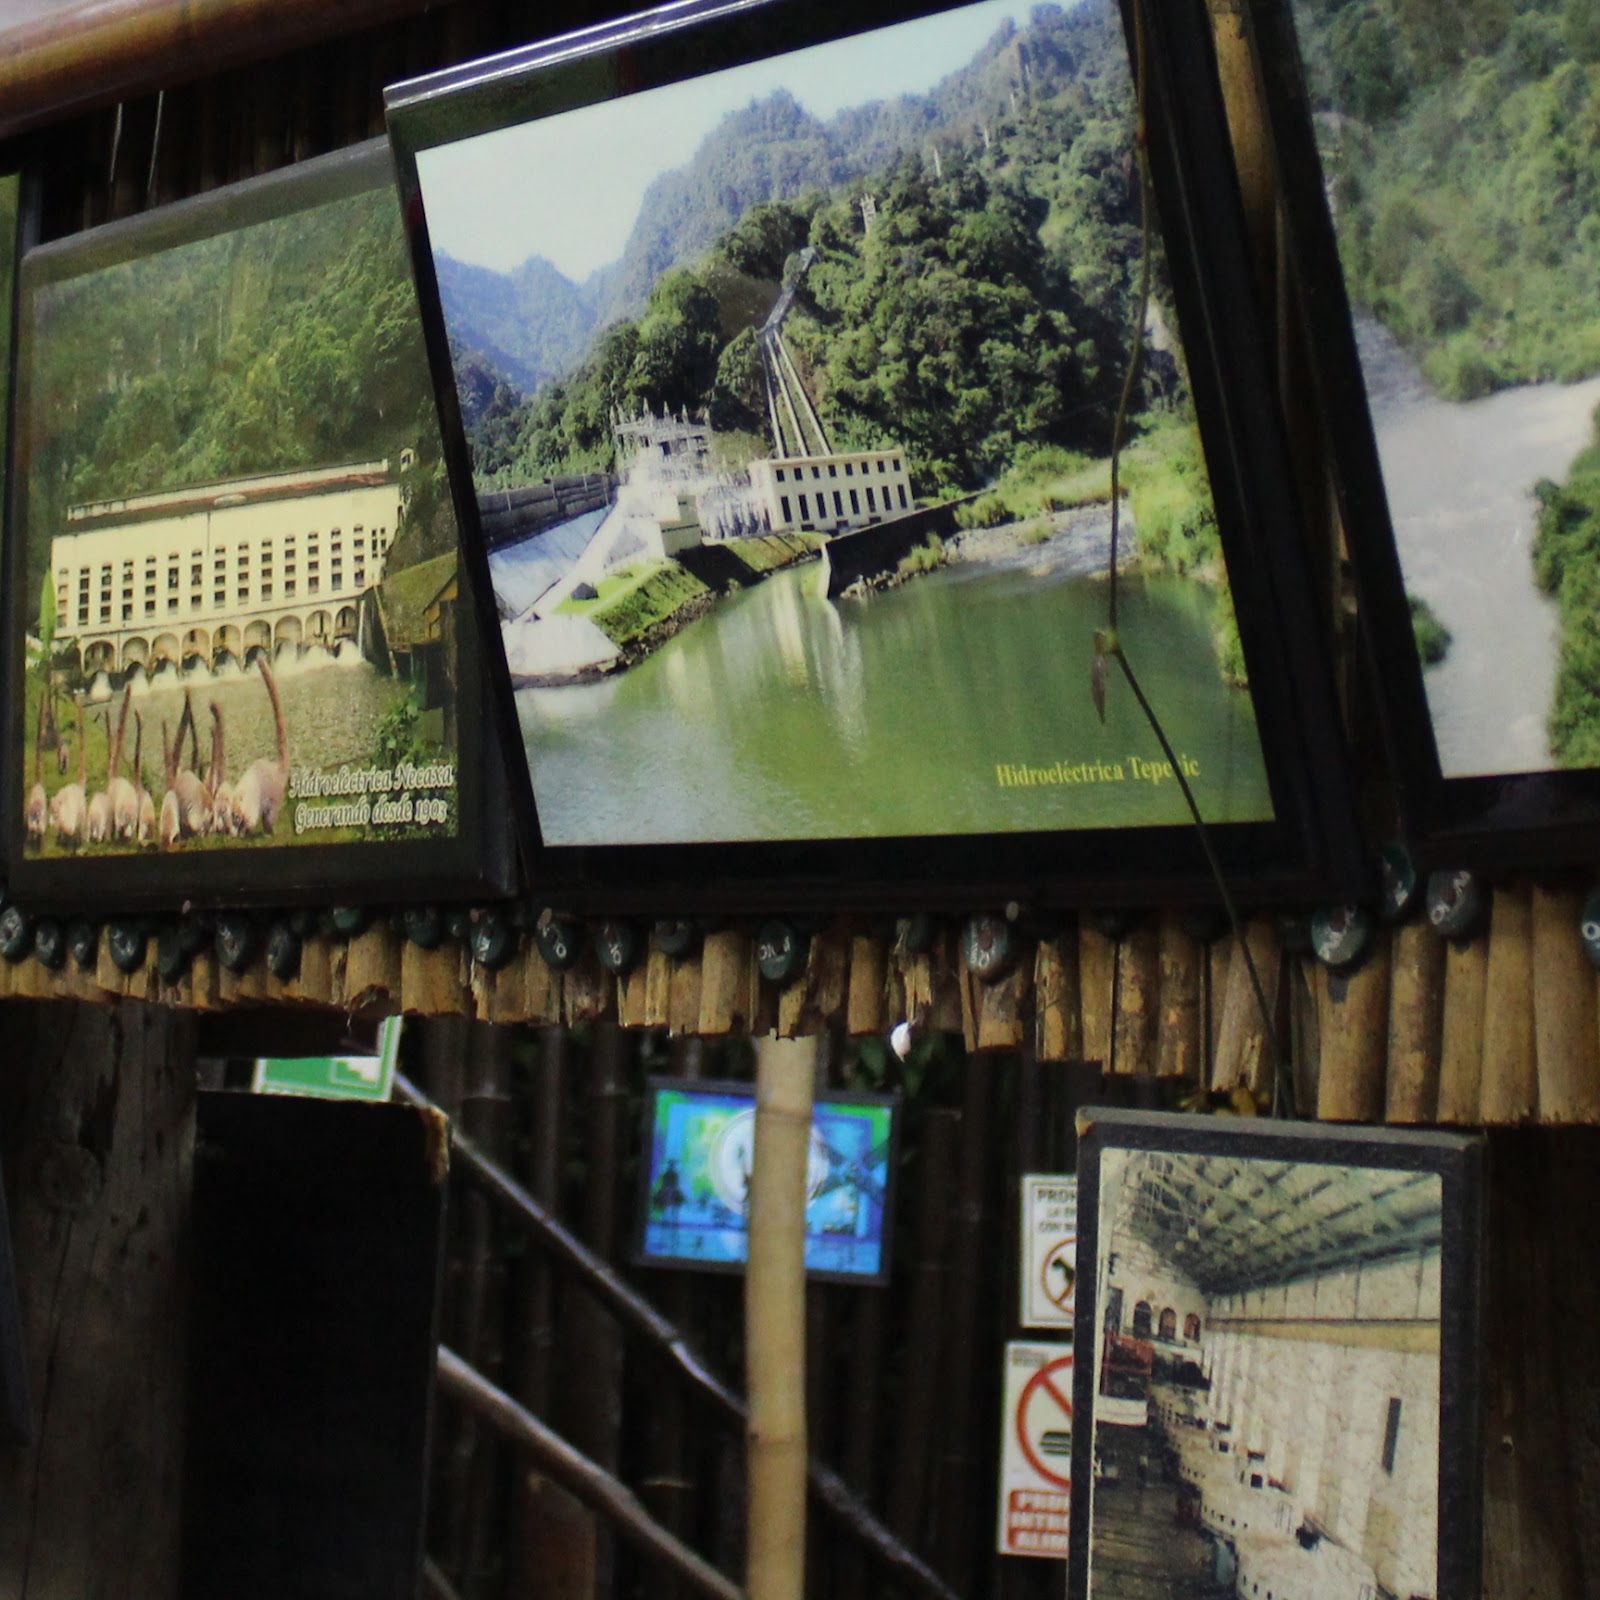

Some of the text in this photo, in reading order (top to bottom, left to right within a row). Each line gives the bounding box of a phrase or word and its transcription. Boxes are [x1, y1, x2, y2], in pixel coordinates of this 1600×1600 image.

[394, 761, 454, 791] Necaxa
[996, 754, 1201, 787] Hidroeléctrica Tepeic
[294, 791, 449, 835] Generando desde 1903
